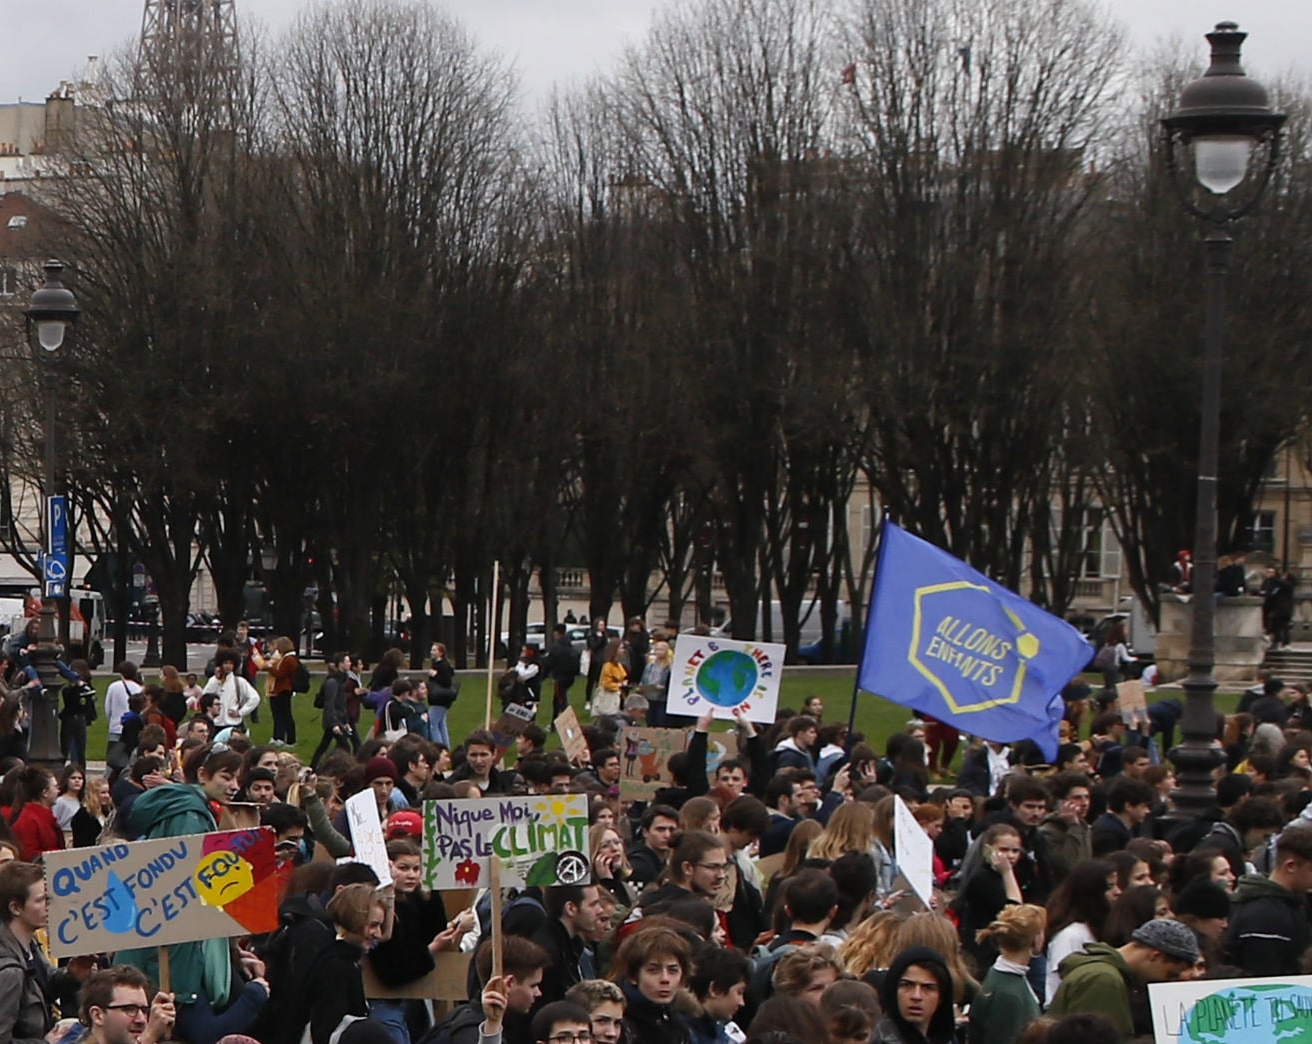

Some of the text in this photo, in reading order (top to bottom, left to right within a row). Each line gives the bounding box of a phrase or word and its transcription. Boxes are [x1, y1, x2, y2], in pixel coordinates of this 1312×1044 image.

[54, 504, 61, 527] P
[925, 636, 1004, 686] ENFANTS
[936, 615, 1012, 660] ALLONS
[682, 649, 705, 706] PLANET
[435, 802, 495, 838] Nique
[436, 835, 473, 862] PAS
[492, 817, 589, 859] CLIMAT
[52, 843, 130, 897] QUAND
[57, 840, 188, 945] C'EST FONDU
[135, 876, 200, 937] C'EST
[1163, 1001, 1190, 1037] LA
[1265, 997, 1284, 1024] TU
